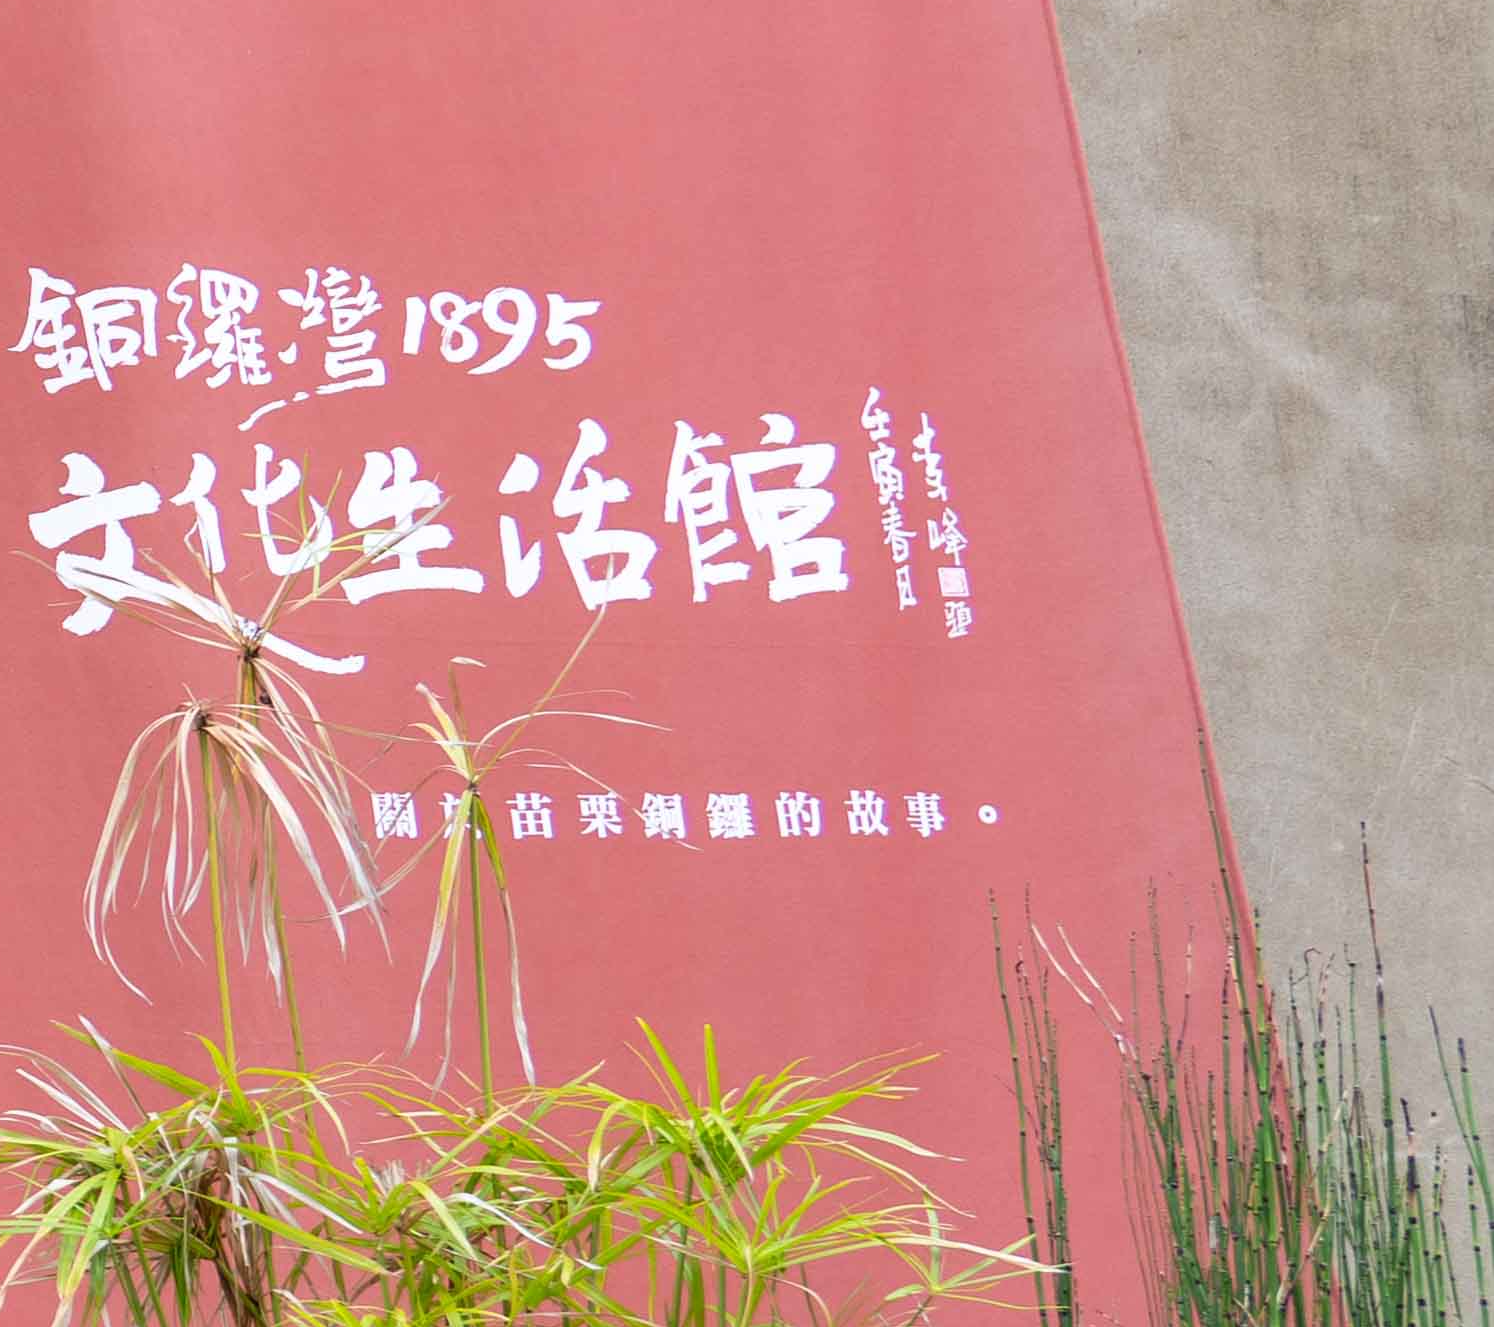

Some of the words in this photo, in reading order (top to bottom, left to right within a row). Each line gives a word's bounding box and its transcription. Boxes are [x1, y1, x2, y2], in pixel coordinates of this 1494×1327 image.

[8, 263, 600, 431] 銅鑼灣1895
[28, 414, 849, 675] 文化生活館
